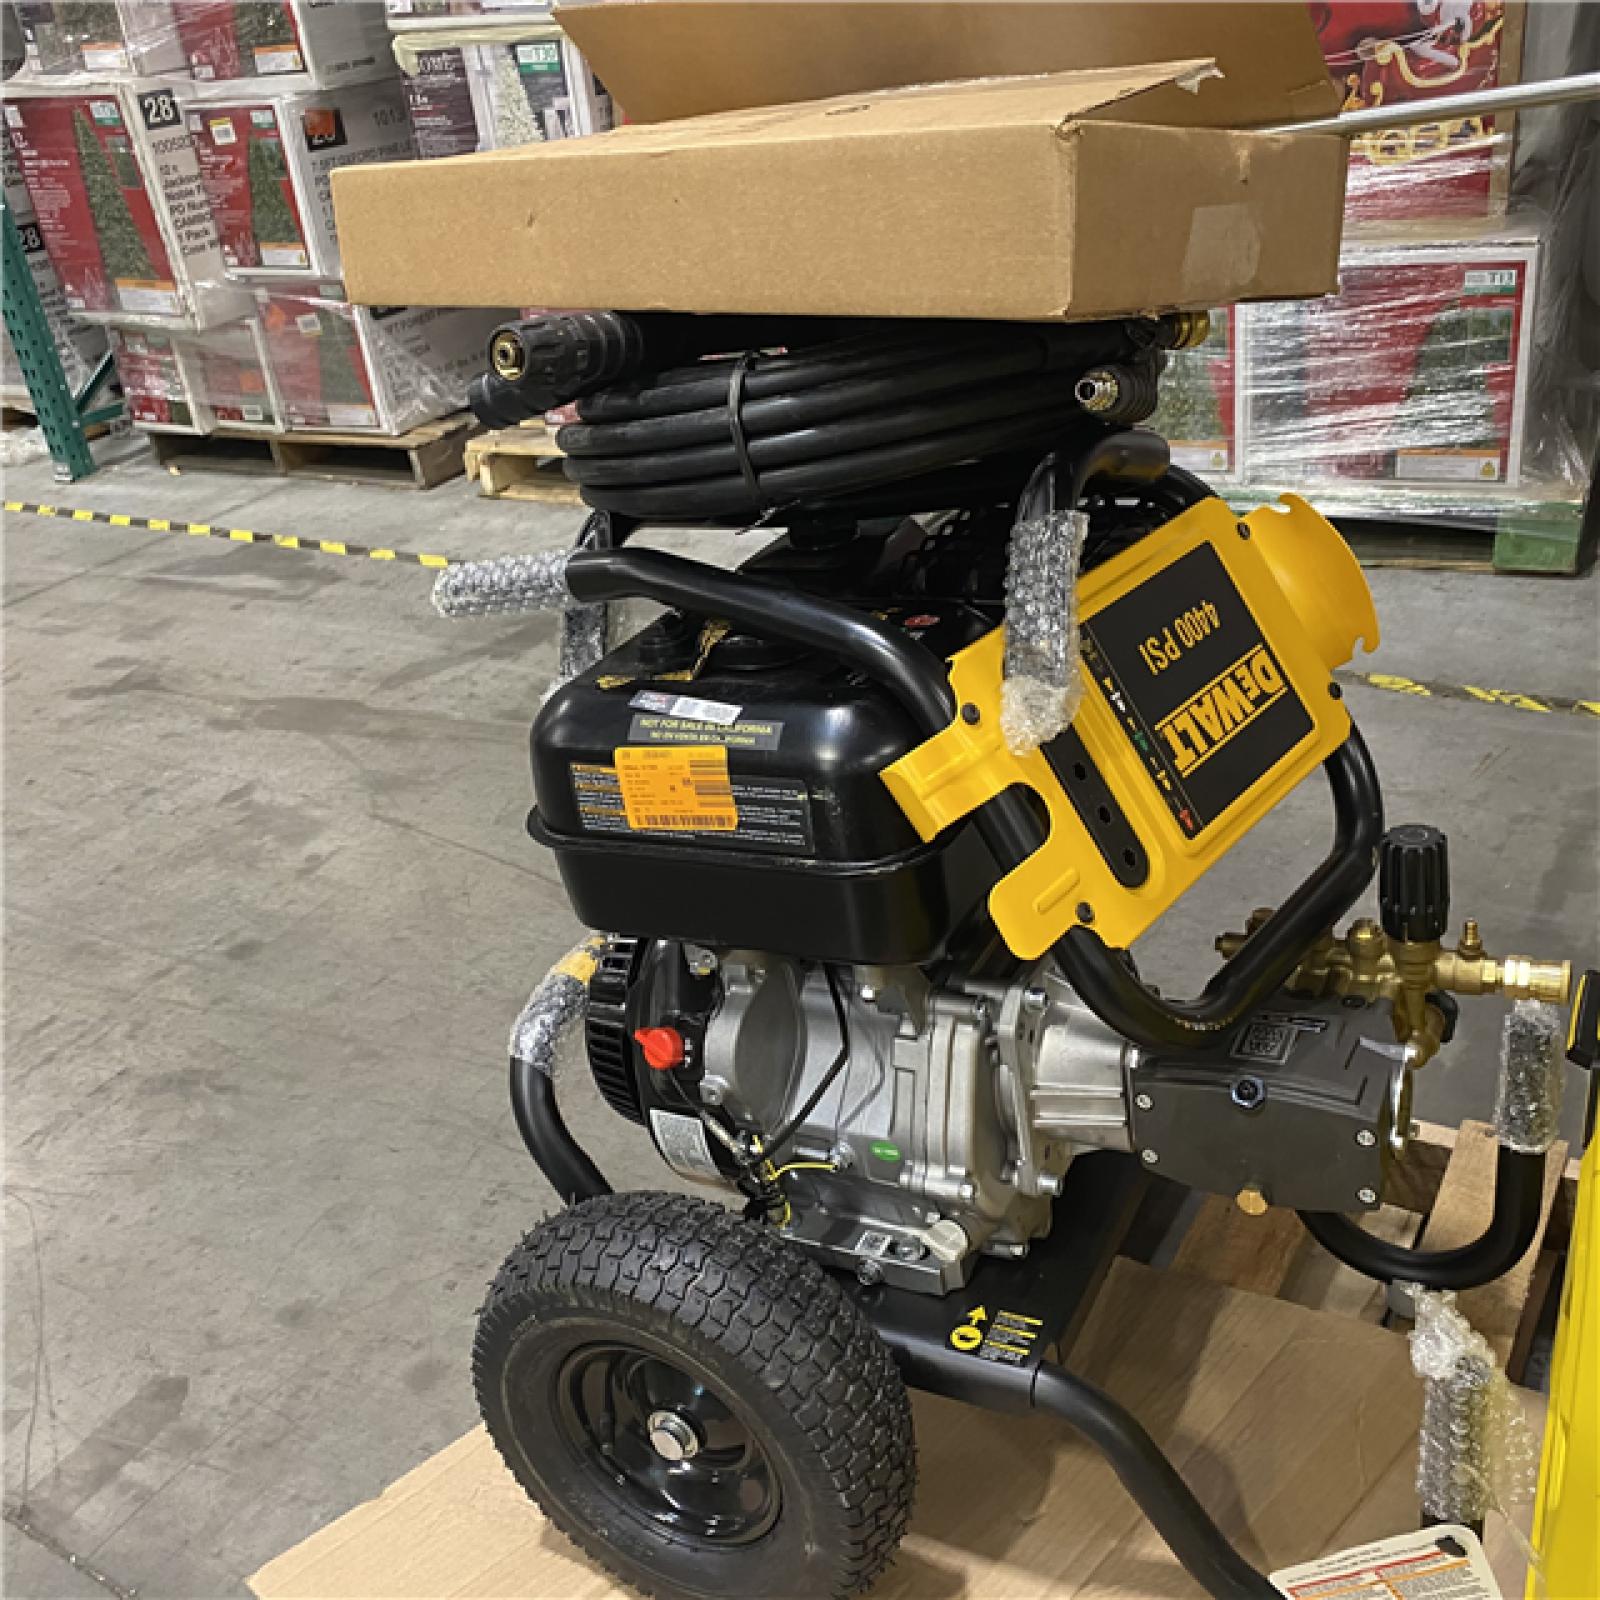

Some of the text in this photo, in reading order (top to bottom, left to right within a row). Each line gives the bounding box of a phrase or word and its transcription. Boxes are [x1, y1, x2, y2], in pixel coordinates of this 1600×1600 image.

[144, 95, 173, 123] 28
[1139, 600, 1221, 675] 4400 PSI
